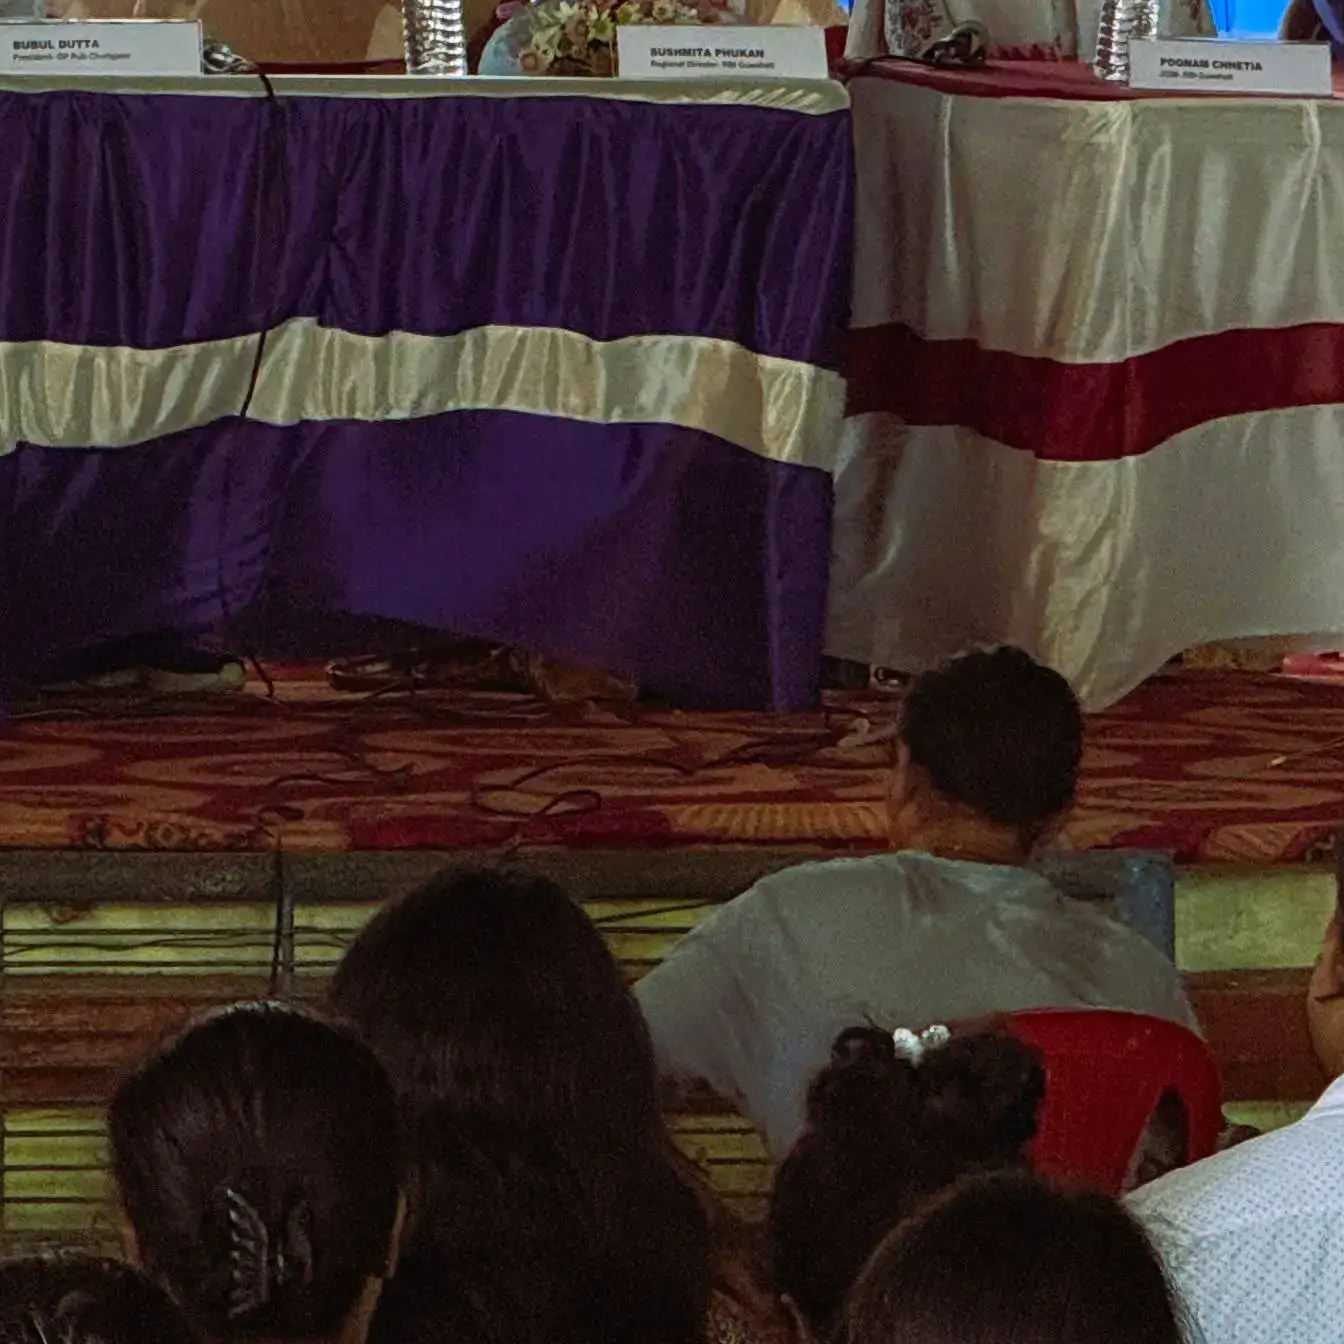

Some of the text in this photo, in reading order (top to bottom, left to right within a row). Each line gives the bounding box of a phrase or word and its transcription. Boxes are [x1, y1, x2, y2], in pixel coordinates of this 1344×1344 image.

[58, 39, 100, 49] DUTTA
[650, 47, 765, 58] SUSHMITA PHUKAN
